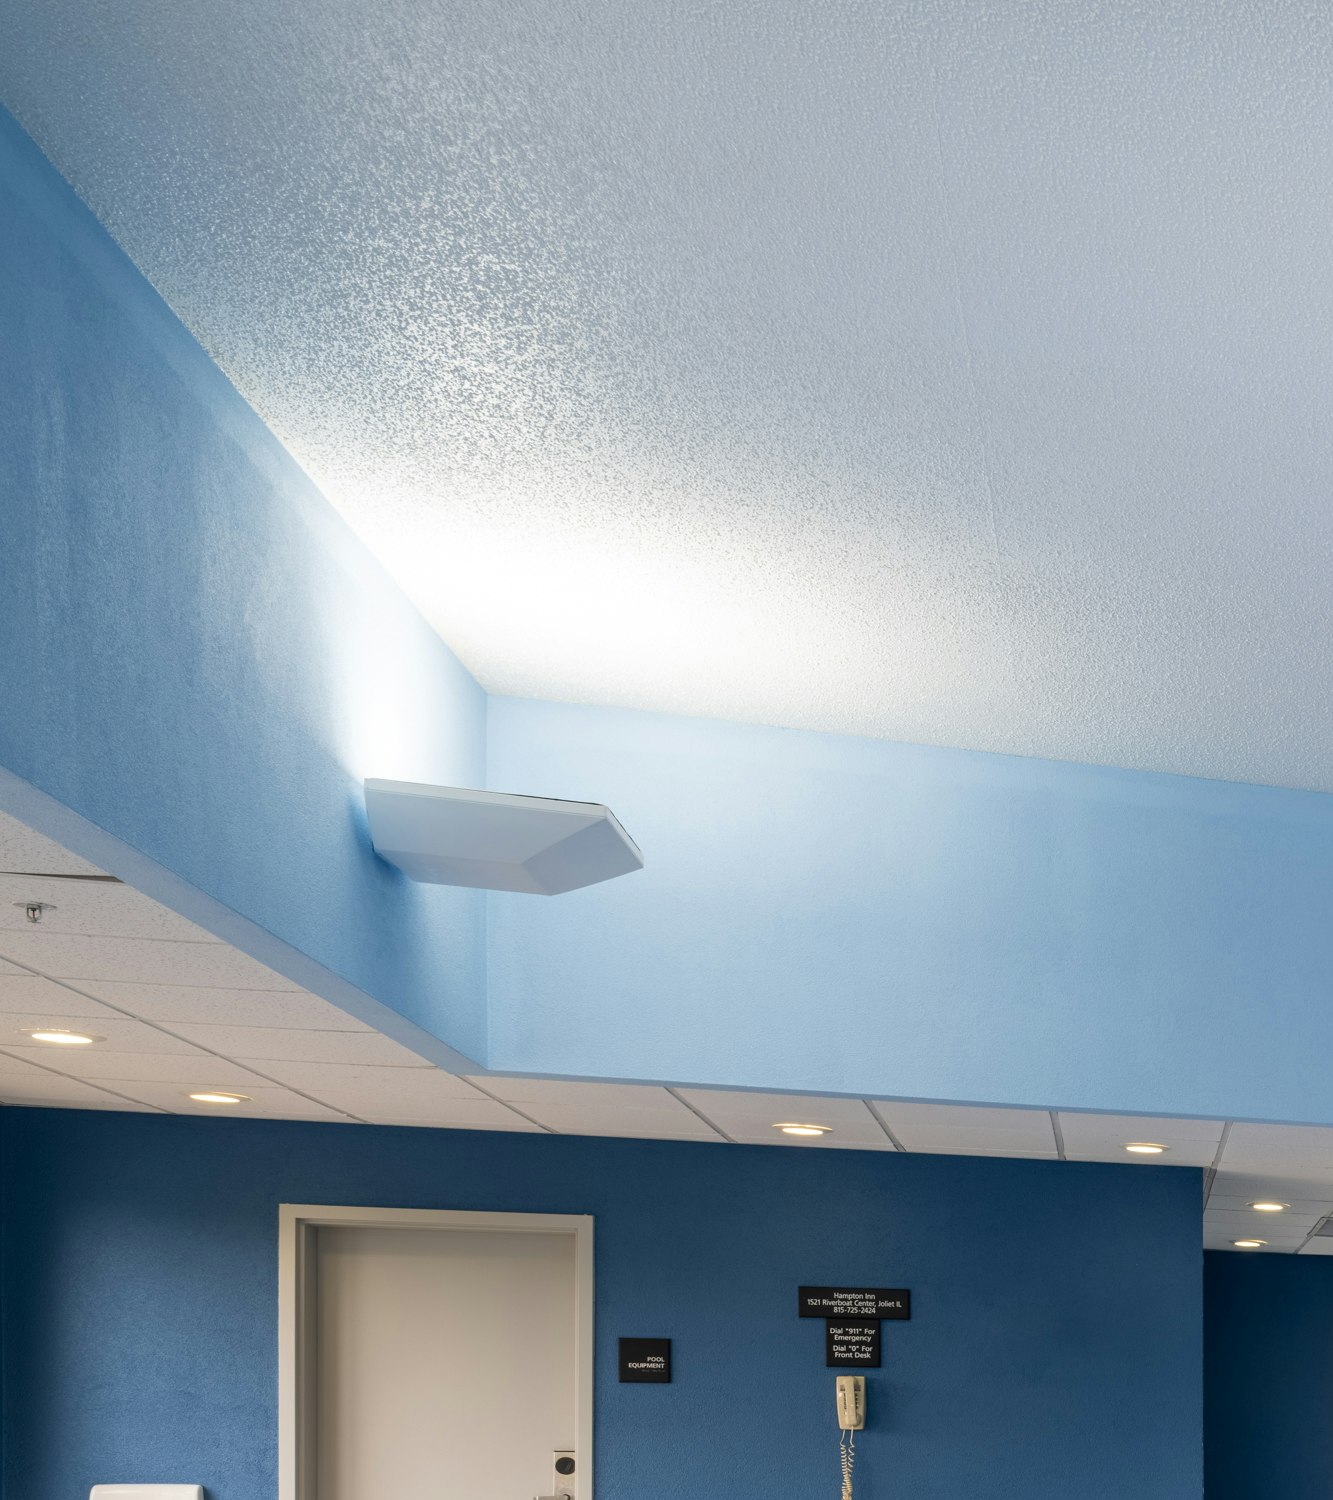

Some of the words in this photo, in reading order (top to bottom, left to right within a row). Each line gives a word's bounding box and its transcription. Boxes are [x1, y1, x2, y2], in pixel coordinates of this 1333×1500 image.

[833, 1292, 864, 1300] Hampton
[854, 1300, 877, 1308] Center,
[834, 1334, 872, 1342] Emergency
